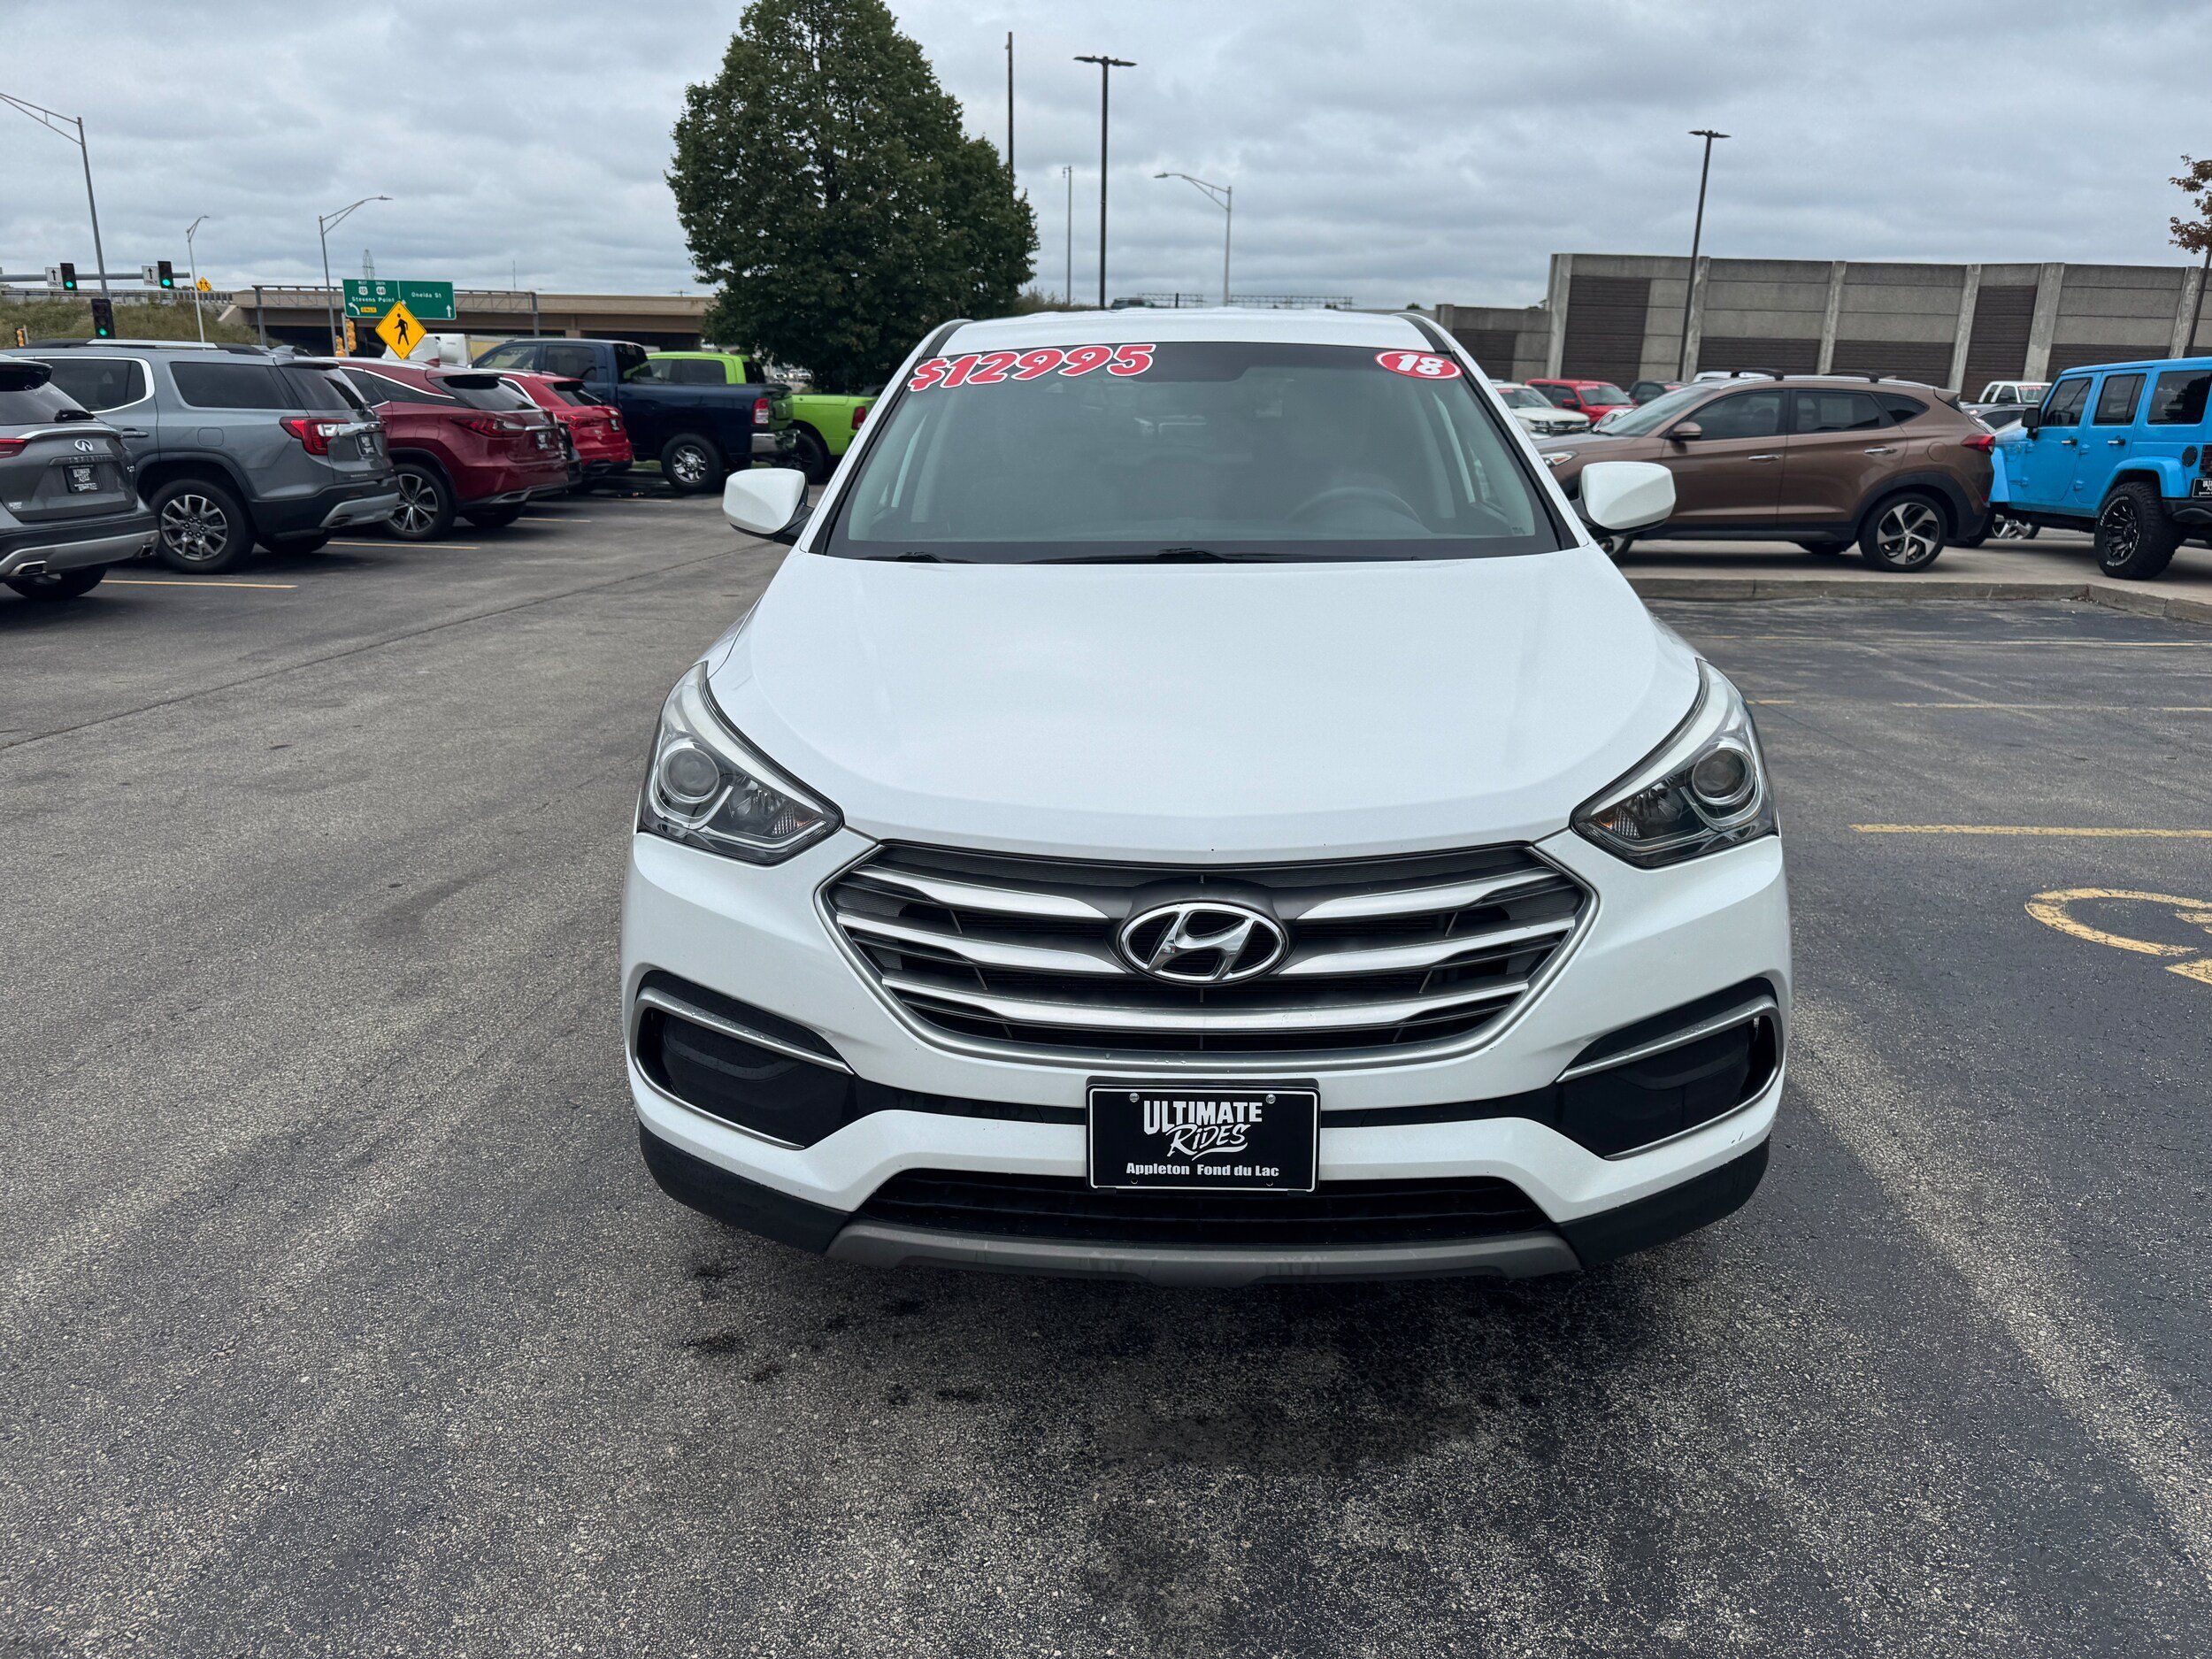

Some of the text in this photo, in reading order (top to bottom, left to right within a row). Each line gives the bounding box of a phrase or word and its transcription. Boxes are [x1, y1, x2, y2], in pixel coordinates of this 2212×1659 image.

[908, 343, 1156, 392] $12995
[1396, 354, 1445, 376] 18
[1143, 1100, 1263, 1136] ULTIMATE
[1125, 1162, 1280, 1178] Appleton Fond du Lac
